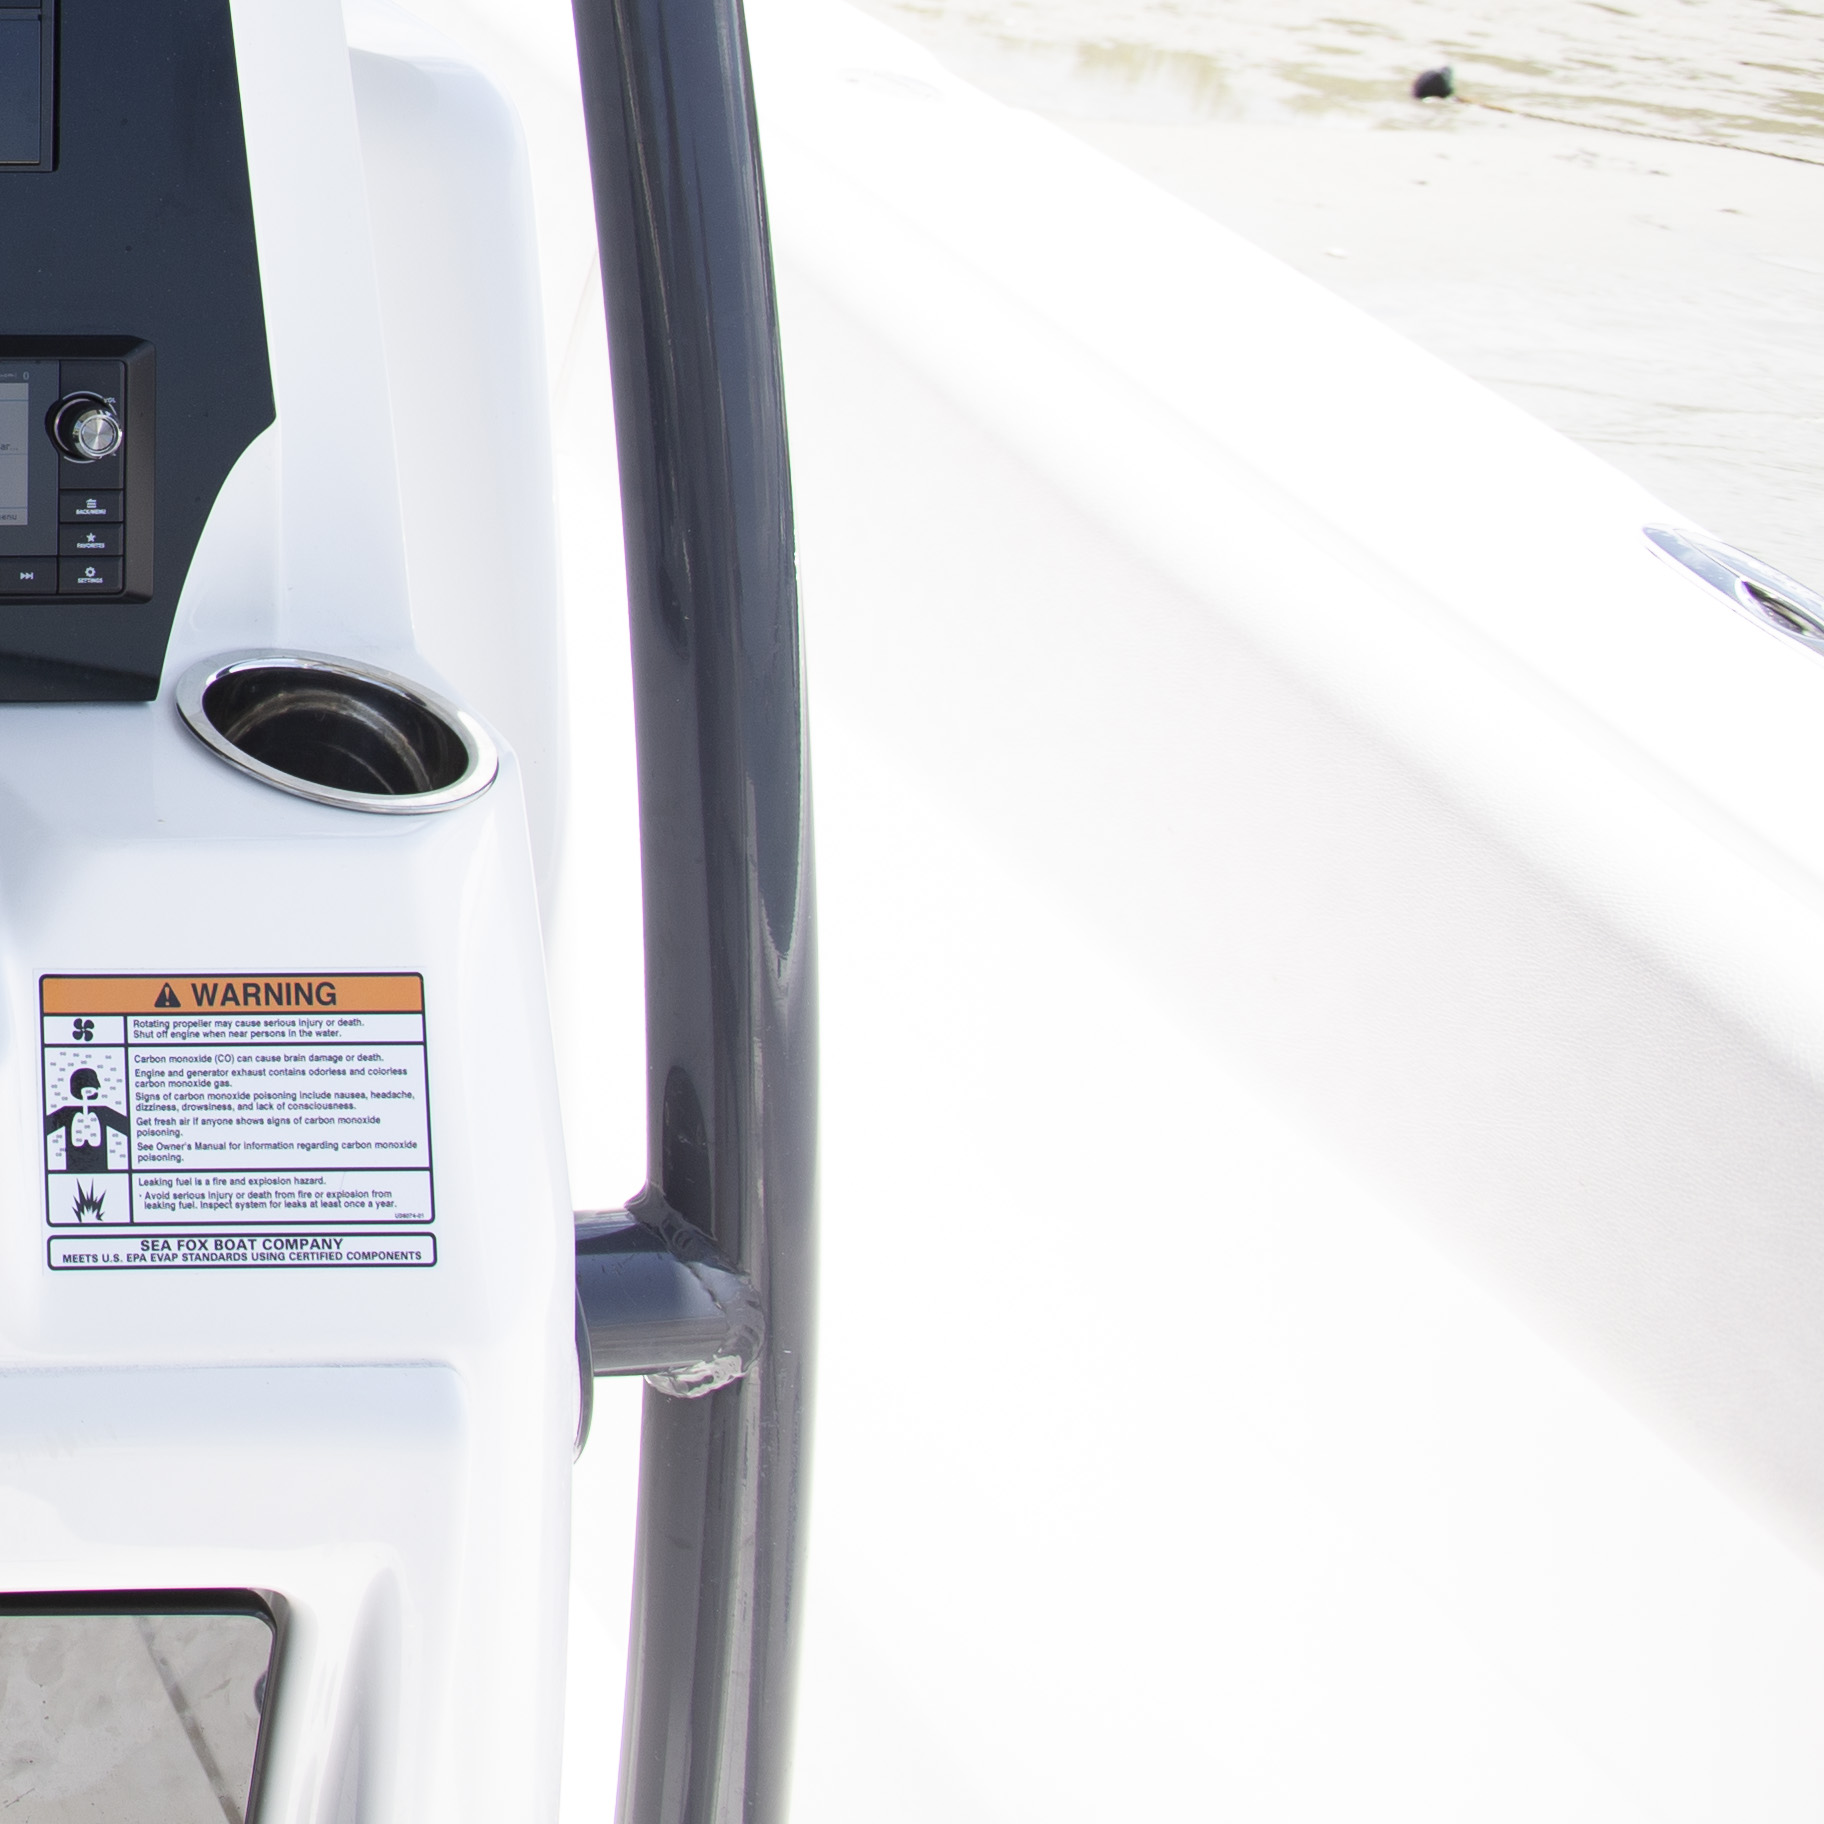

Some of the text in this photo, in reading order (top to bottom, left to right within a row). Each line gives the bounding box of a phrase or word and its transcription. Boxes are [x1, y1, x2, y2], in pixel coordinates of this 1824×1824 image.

[191, 981, 336, 1007] WARNING
[133, 1018, 365, 1030] Rotating propeller may cause serious injury or death.
[140, 1238, 343, 1252] SEA FOX BOAT COMPANY
[62, 1251, 422, 1264] MEETS U.S. EPA EVAP STANDARDS USING CERTIFIED COMPONENTS
